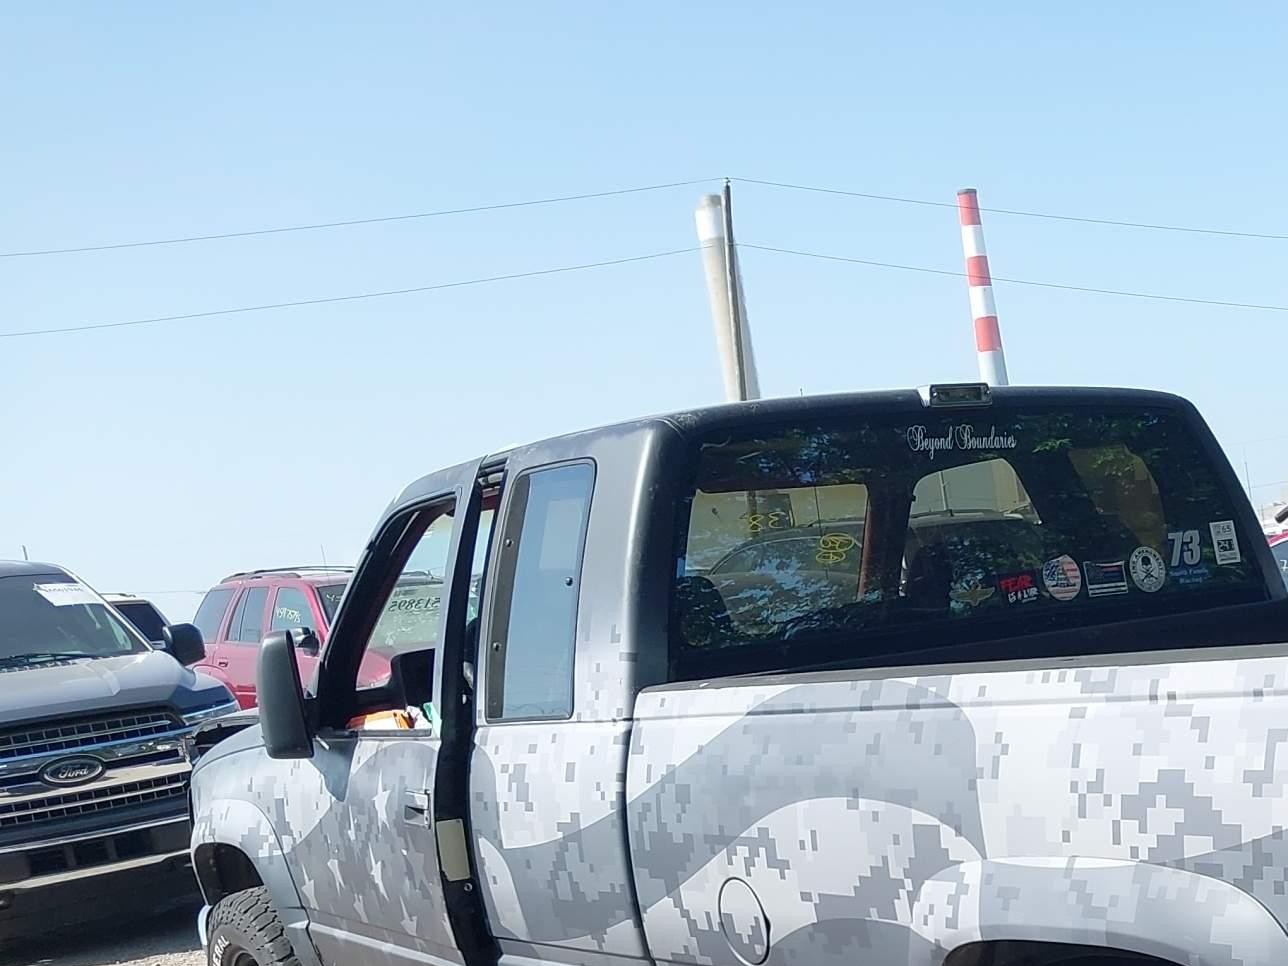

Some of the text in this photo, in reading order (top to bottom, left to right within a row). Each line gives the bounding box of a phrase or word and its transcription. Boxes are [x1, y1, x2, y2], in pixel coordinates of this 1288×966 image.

[906, 424, 1017, 461] Beyond Boundaries
[1167, 529, 1201, 567] 73
[58, 765, 90, 779] Ford
